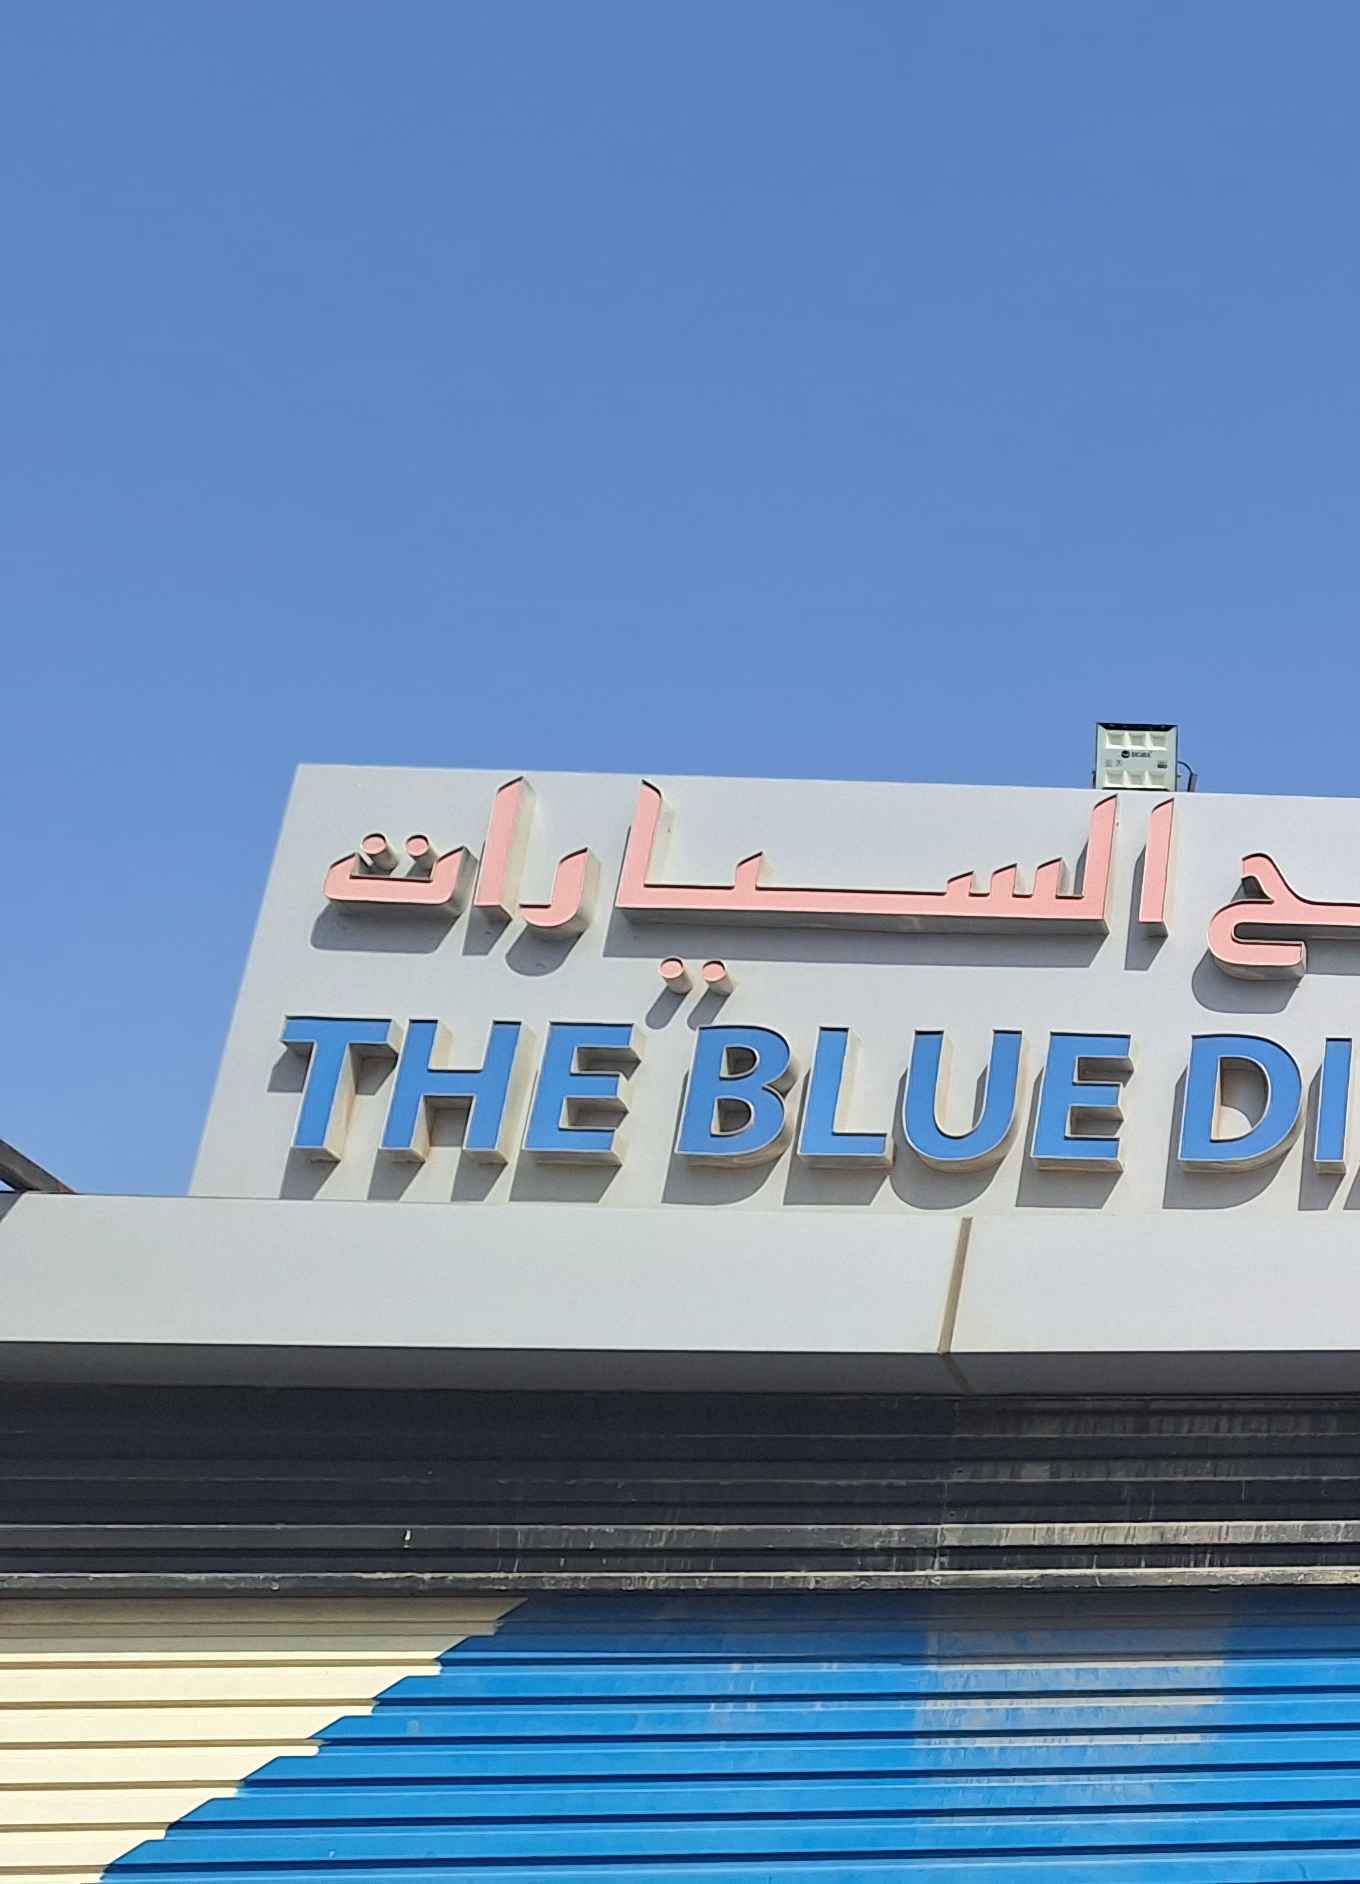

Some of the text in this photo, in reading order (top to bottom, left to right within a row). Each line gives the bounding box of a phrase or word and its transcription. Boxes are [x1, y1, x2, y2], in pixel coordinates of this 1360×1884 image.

[323, 777, 1175, 987] السيارات
[281, 1017, 633, 1152] THE
[679, 1027, 1131, 1161] BLUE
